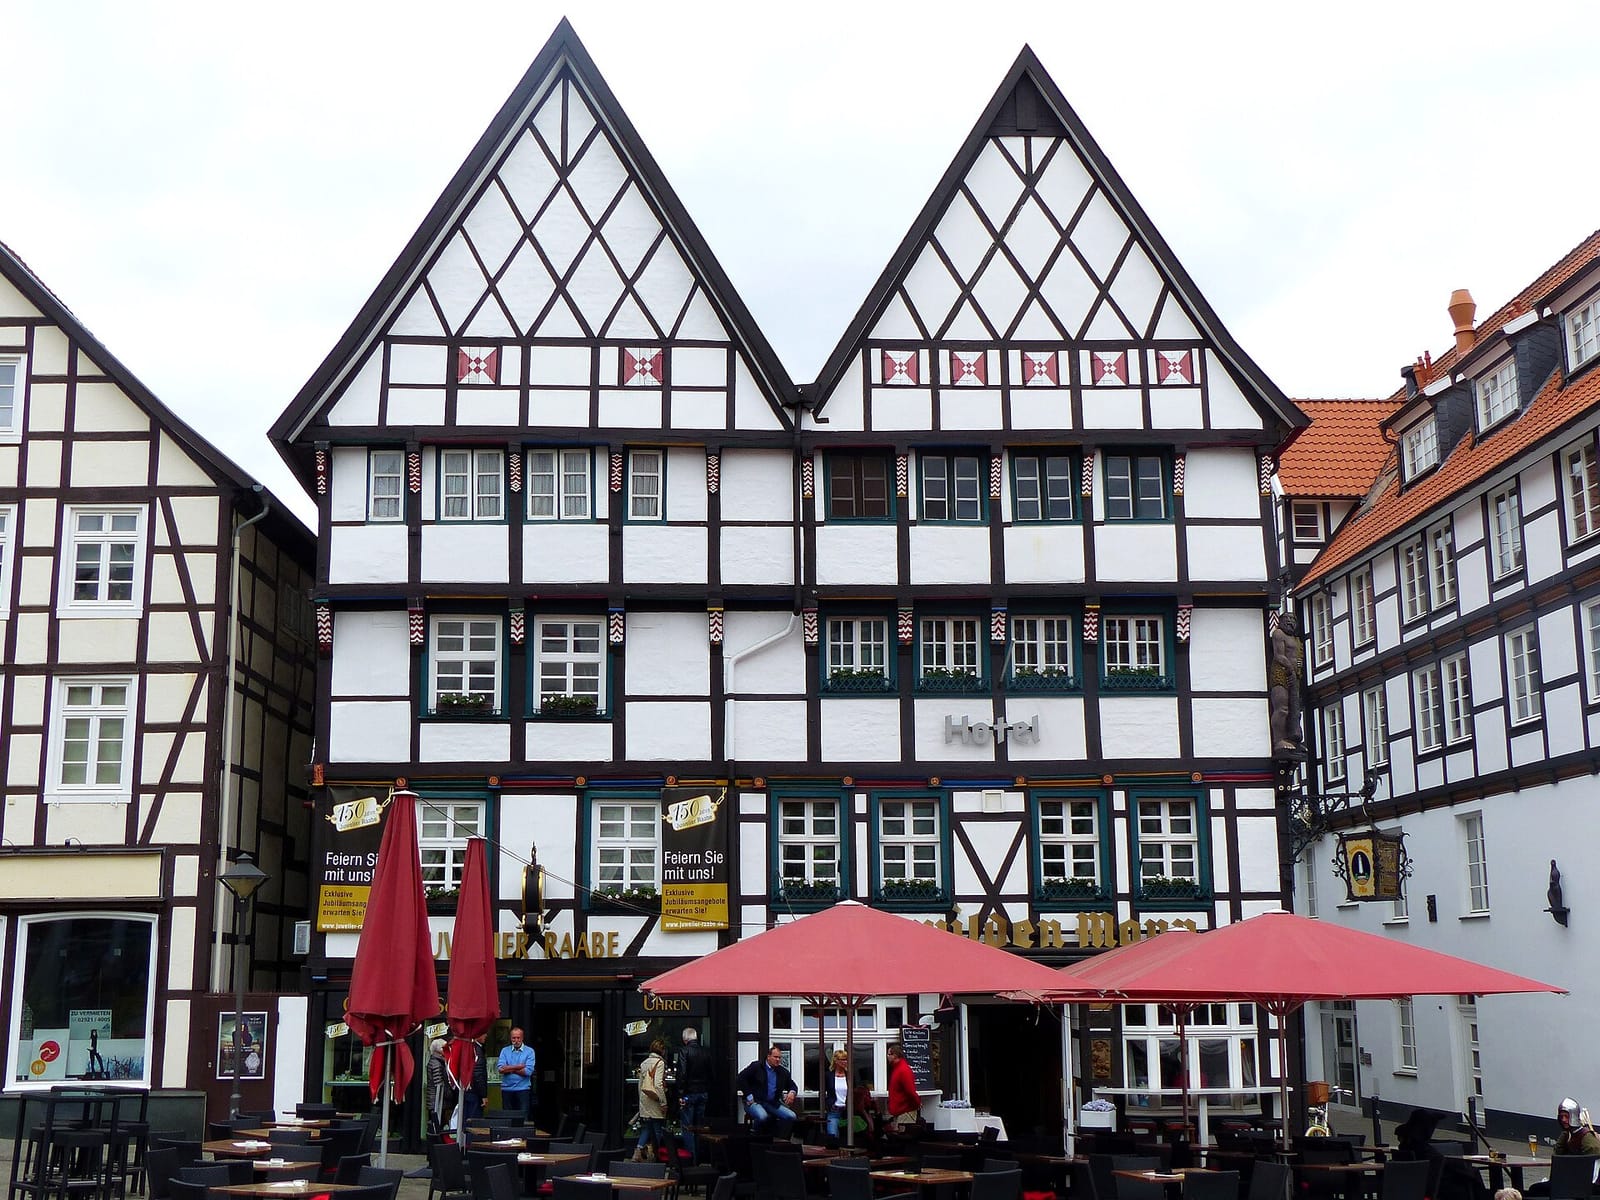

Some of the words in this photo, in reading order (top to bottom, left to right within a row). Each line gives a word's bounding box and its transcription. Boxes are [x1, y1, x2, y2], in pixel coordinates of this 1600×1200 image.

[944, 714, 1040, 745] Hotel
[338, 801, 364, 822] 150
[674, 800, 699, 821] 150
[326, 852, 362, 866] Feiern
[366, 852, 379, 866] Si
[664, 851, 701, 865] Feiern
[705, 850, 724, 864] Sie
[325, 868, 344, 881] mit
[348, 868, 375, 882] uns!
[664, 866, 684, 880] mit
[688, 865, 715, 880] uns!
[324, 890, 353, 898] Exklusive
[323, 900, 367, 908] Jubiläumsang
[665, 898, 726, 906] Jubiläumsangebote
[914, 902, 1065, 950] ilden
[544, 931, 620, 959] RAABE
[643, 994, 692, 1012] UHREN
